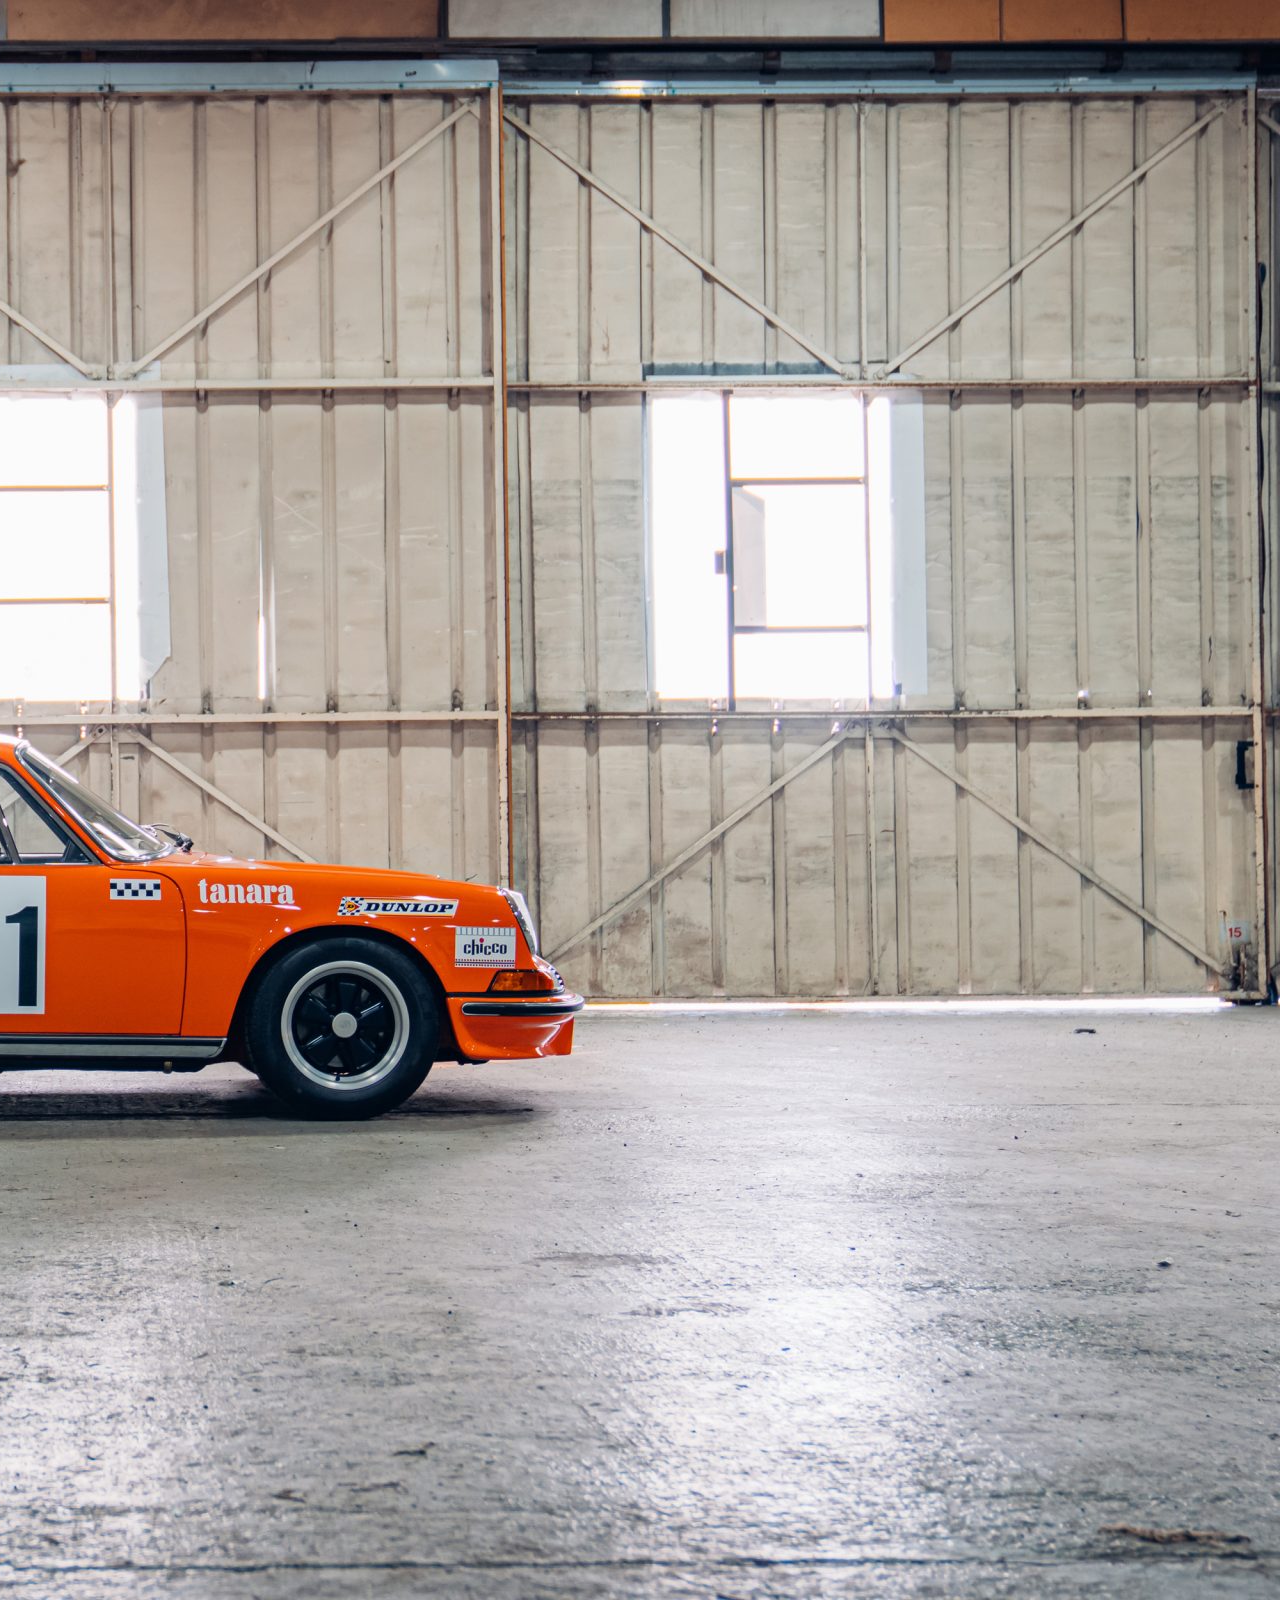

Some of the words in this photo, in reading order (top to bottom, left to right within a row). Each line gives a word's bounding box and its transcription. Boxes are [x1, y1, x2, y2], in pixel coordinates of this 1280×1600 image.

[198, 878, 295, 904] tanara
[364, 902, 454, 913] DUNLOP
[1228, 927, 1242, 938] 15
[463, 937, 507, 956] chicco
